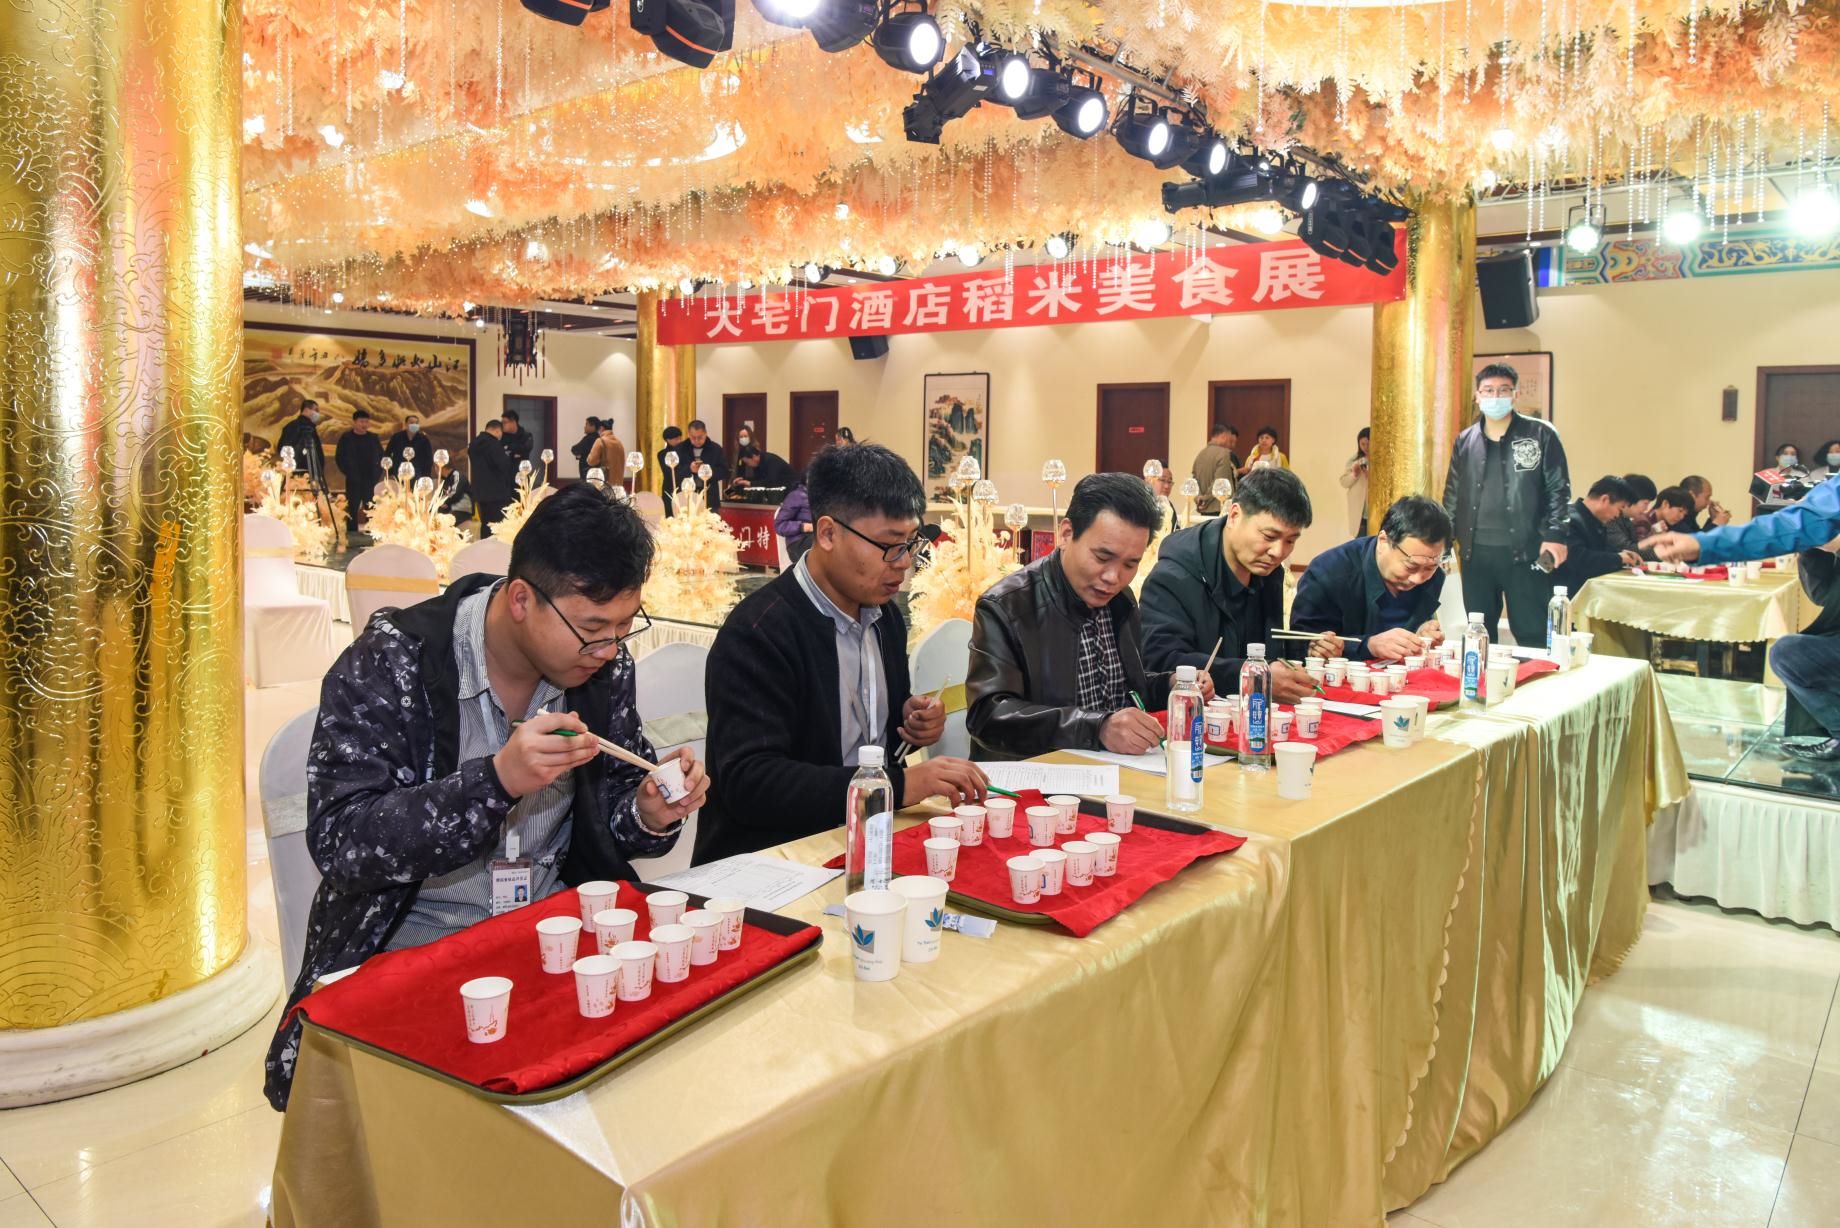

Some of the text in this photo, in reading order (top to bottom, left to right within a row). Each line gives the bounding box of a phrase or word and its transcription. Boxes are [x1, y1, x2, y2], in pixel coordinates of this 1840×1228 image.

[706, 248, 1325, 338] 大宅门酒店稻米美食展
